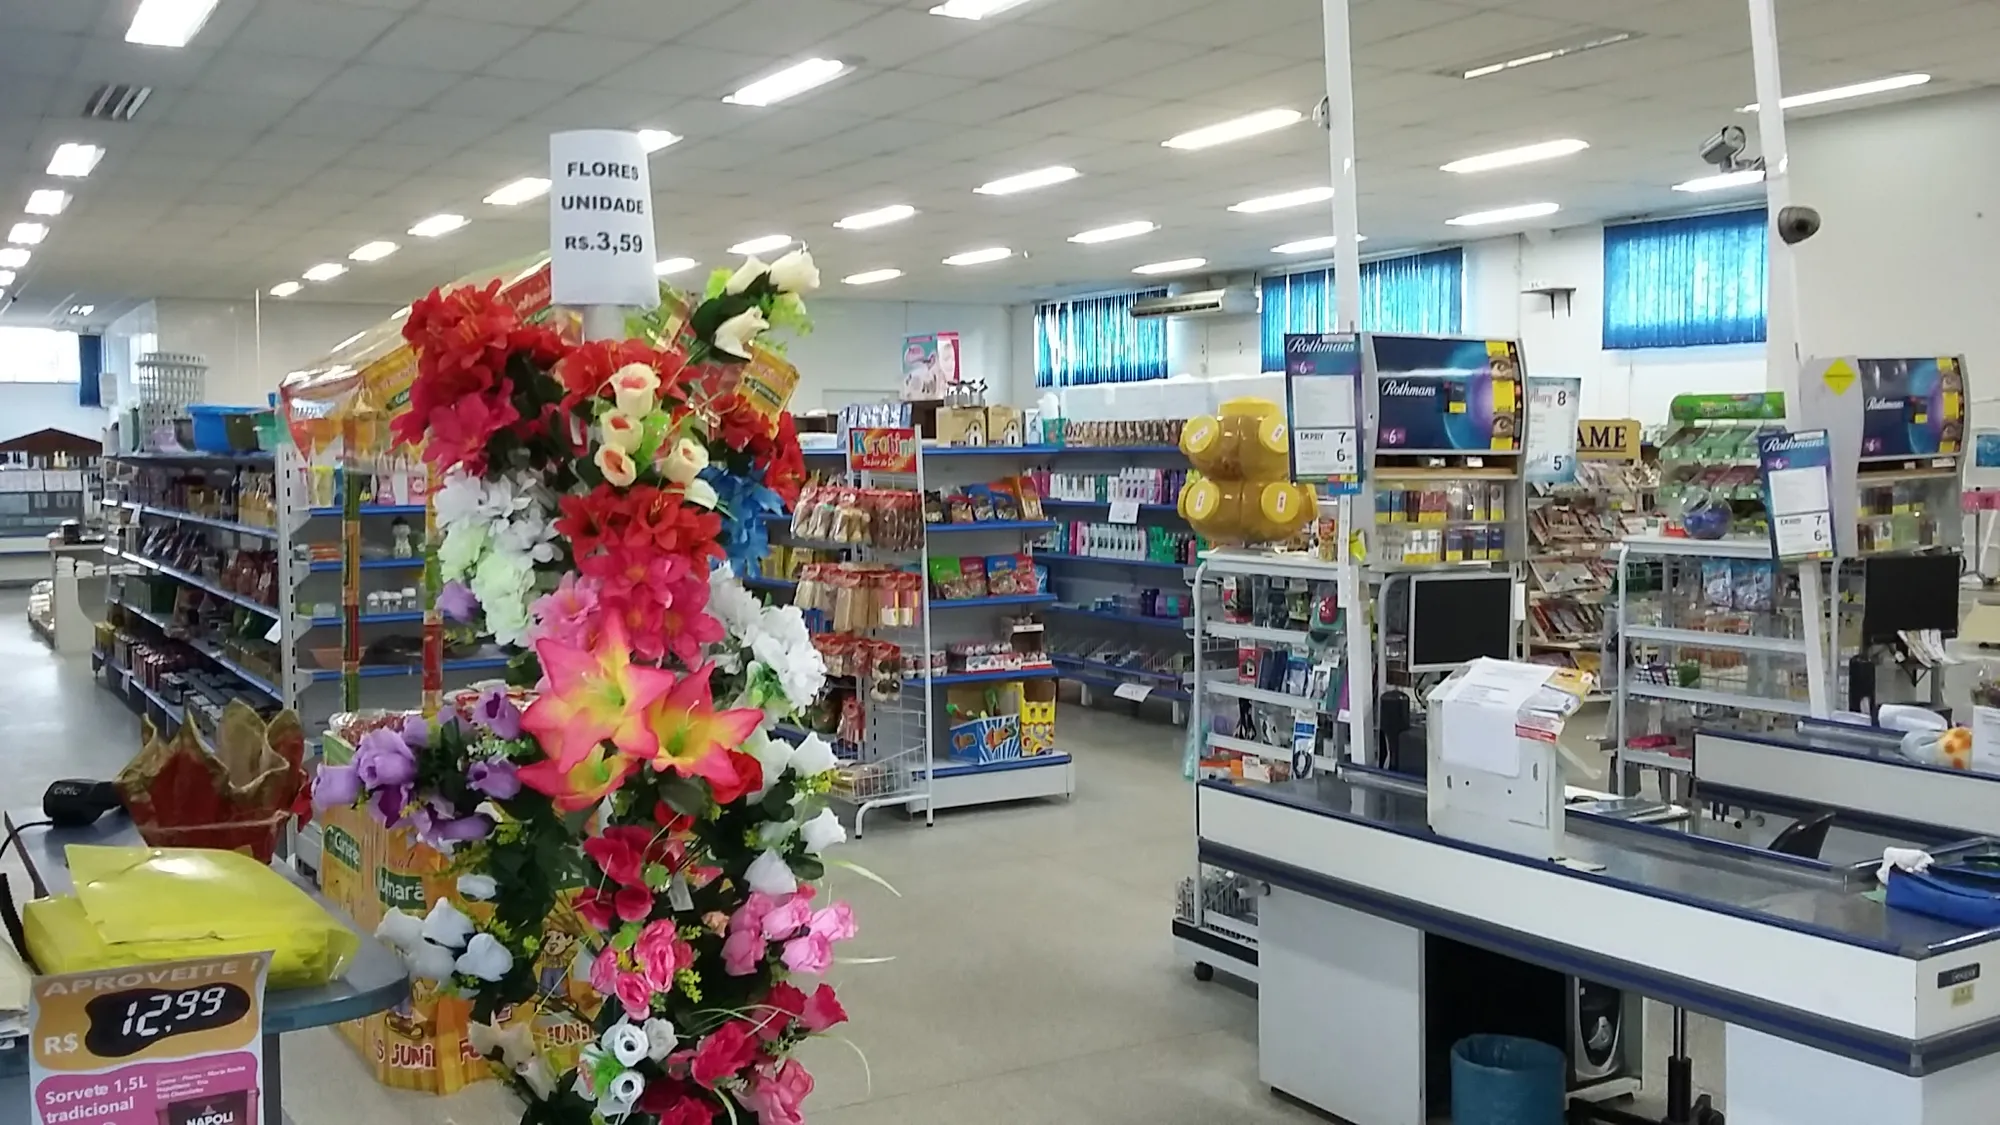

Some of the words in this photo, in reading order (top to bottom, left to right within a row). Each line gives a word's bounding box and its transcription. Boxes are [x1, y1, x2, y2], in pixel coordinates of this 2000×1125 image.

[567, 162, 639, 181] FLORES
[561, 195, 644, 215] UNIDADE
[1287, 336, 1355, 353] Rothmans
[1381, 379, 1436, 396] Rothmans
[1557, 390, 1566, 406] 8
[1338, 431, 1347, 444] 7
[1762, 436, 1825, 453] Rothmans
[1336, 448, 1346, 462] 6
[1553, 455, 1562, 471] 5
[44, 961, 238, 996] APROVEITE
[44, 1033, 79, 1055] R$
[45, 1083, 109, 1105] Sorvete
[114, 1075, 148, 1095] 1,5L
[46, 1096, 134, 1124] tradicional
